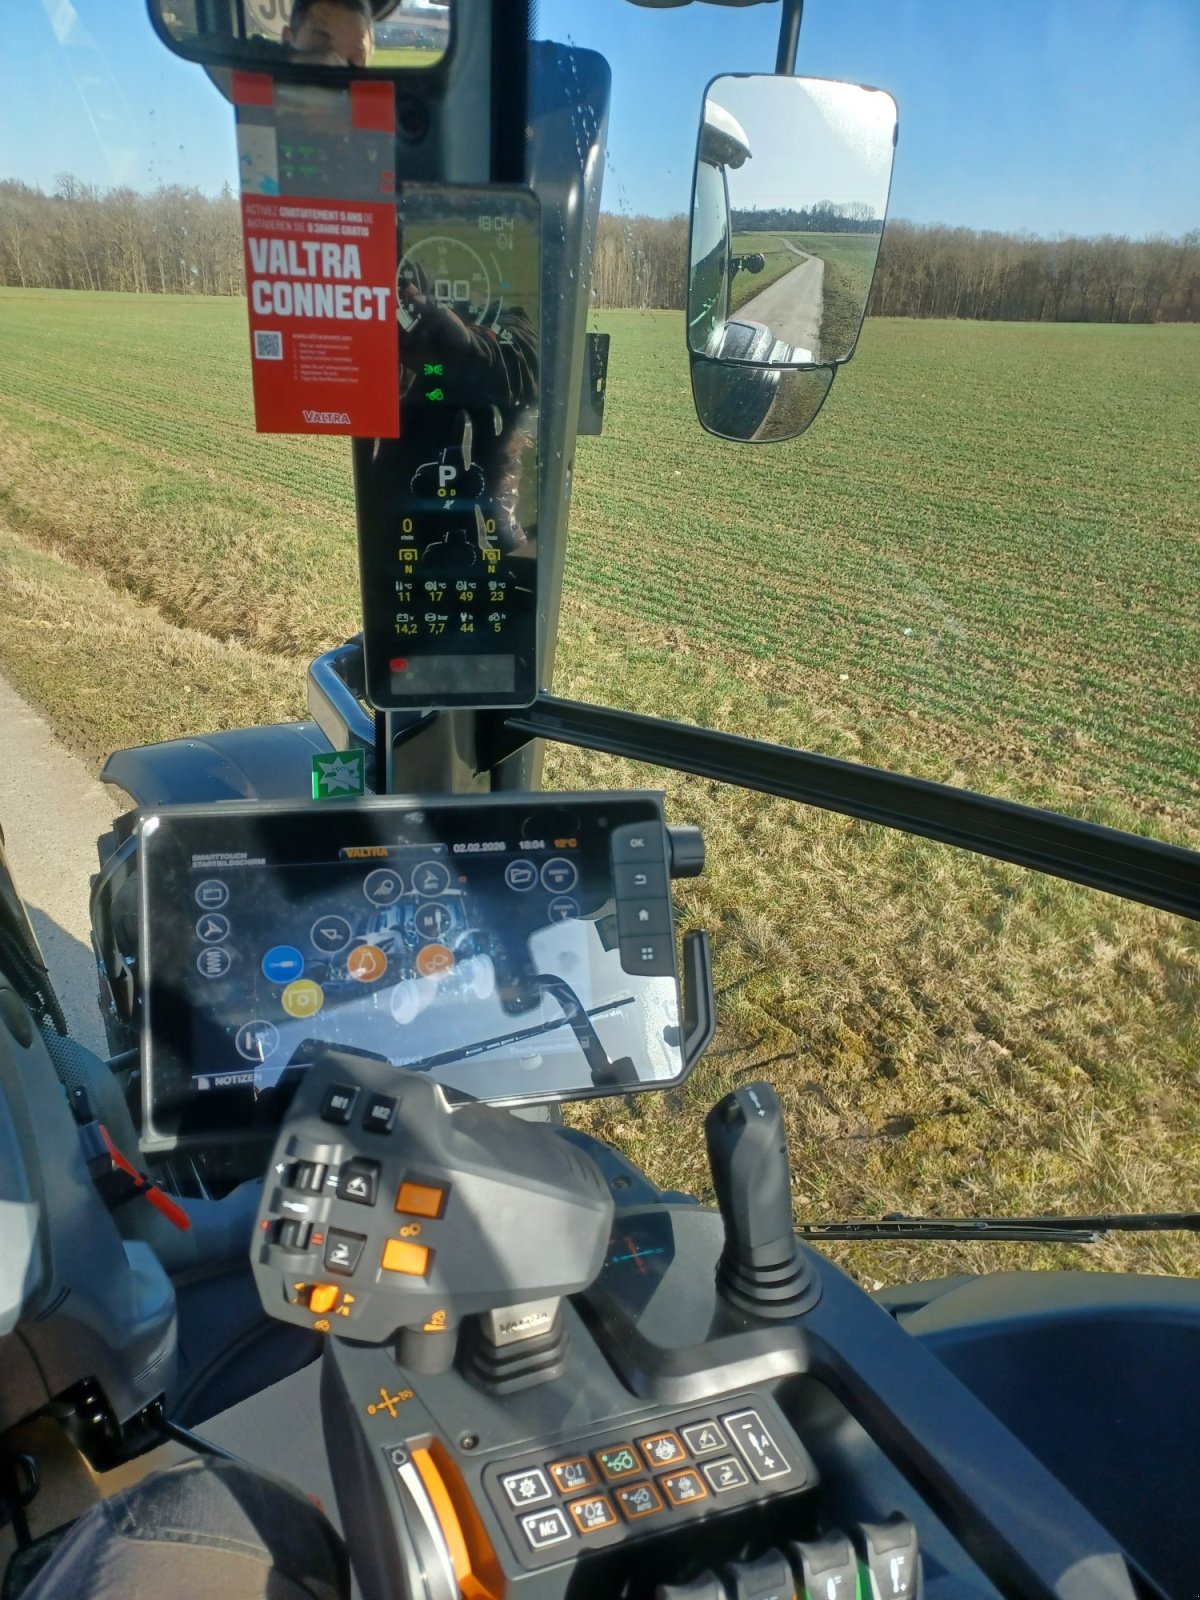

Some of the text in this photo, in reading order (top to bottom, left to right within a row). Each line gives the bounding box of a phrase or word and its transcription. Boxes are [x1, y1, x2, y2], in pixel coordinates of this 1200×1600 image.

[248, 237, 362, 280] VALTRA
[252, 280, 391, 321] CONNECT
[302, 410, 351, 425] VALTRA
[438, 465, 457, 488] P
[402, 518, 413, 533] 0
[486, 519, 496, 533] 0
[404, 565, 413, 574] N
[487, 565, 496, 574] N
[398, 592, 411, 602] 11
[429, 591, 443, 601] 17
[459, 591, 474, 601] 49
[490, 591, 504, 601] 23
[394, 623, 418, 635] 14,2
[428, 623, 446, 635] 7,7
[460, 623, 474, 633] 44
[494, 623, 501, 633] 5
[518, 839, 545, 850] 18:04
[629, 838, 645, 848] OK
[346, 847, 389, 859] VALTRA
[215, 1072, 262, 1087] NOTIZEN
[330, 1095, 349, 1110] M1
[371, 1105, 391, 1120] M2
[760, 1434, 770, 1447] A
[680, 1488, 695, 1499] AUTO
[595, 1503, 605, 1515] 2
[636, 1501, 652, 1512] AUTO
[539, 1518, 557, 1537] M3
